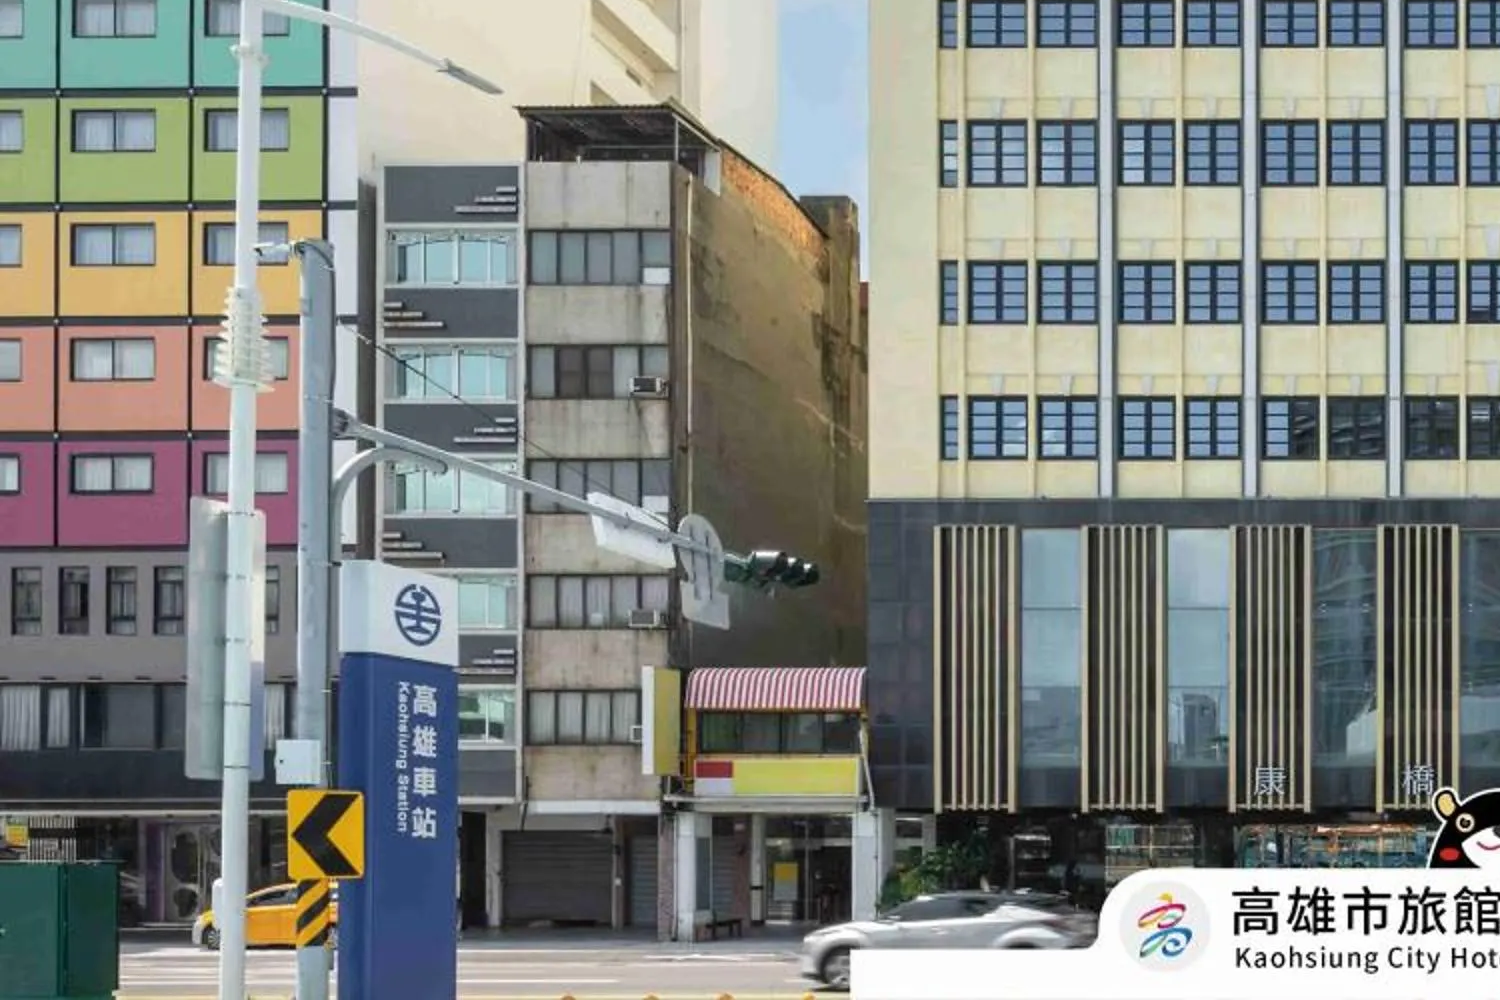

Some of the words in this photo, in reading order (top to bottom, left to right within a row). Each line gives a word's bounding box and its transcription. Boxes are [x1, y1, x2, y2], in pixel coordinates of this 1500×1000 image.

[396, 680, 410, 769] Kaohsiung
[411, 684, 437, 839] 高雄車站
[397, 775, 410, 833] Station
